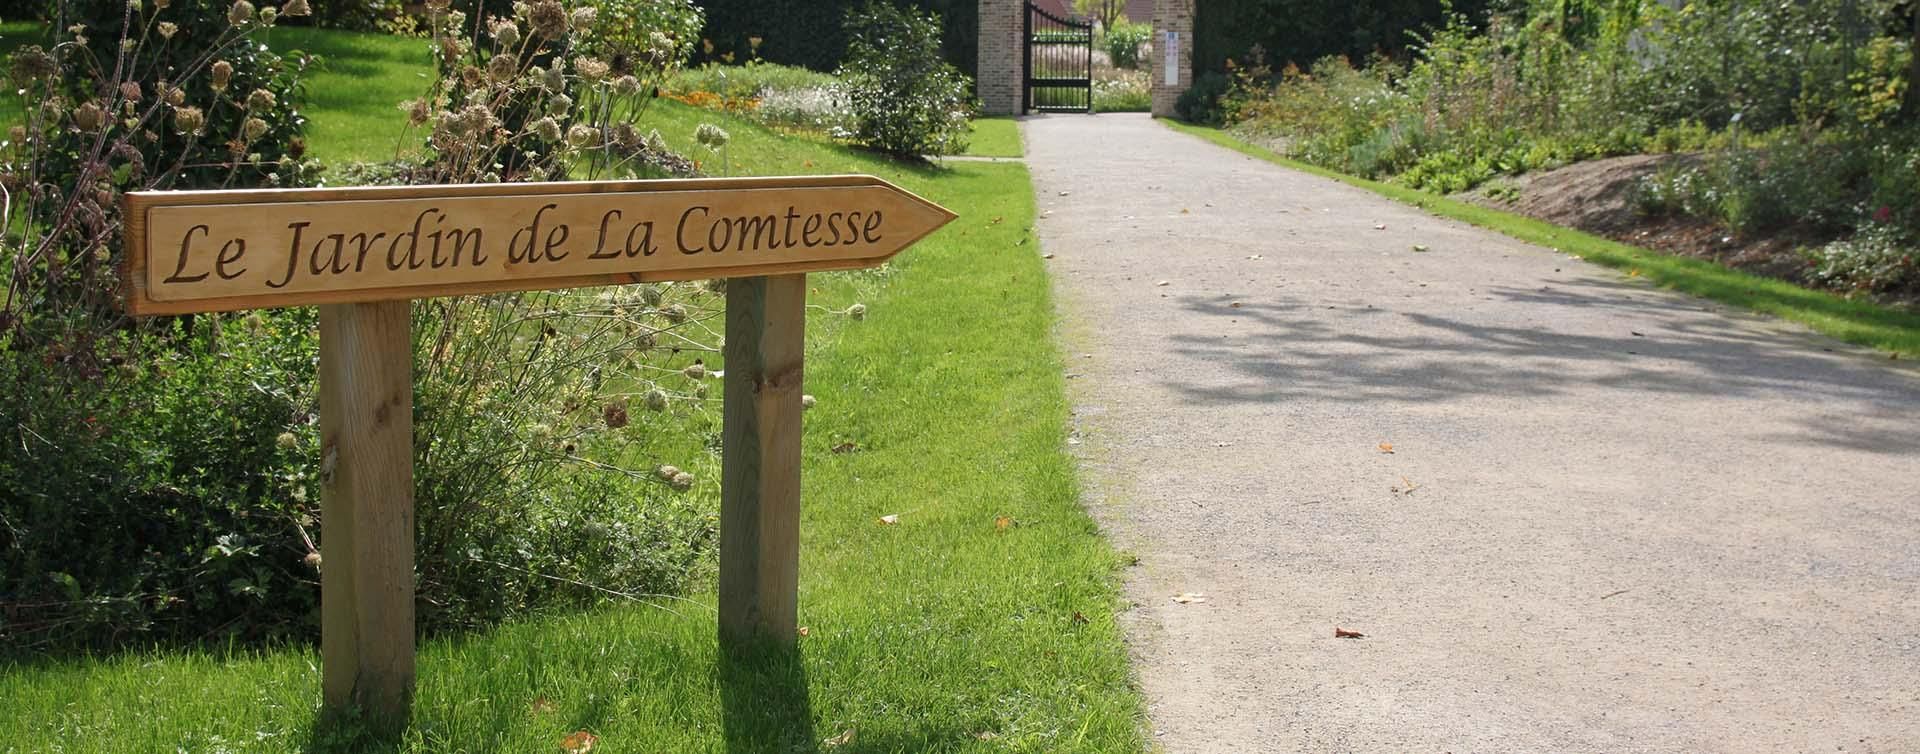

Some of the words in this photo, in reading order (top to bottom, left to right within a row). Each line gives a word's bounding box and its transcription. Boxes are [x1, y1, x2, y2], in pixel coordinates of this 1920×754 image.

[163, 224, 248, 284] Le
[265, 207, 488, 289] Jardin
[508, 203, 570, 263] de
[588, 208, 658, 260] La
[675, 204, 884, 255] Comtesse
